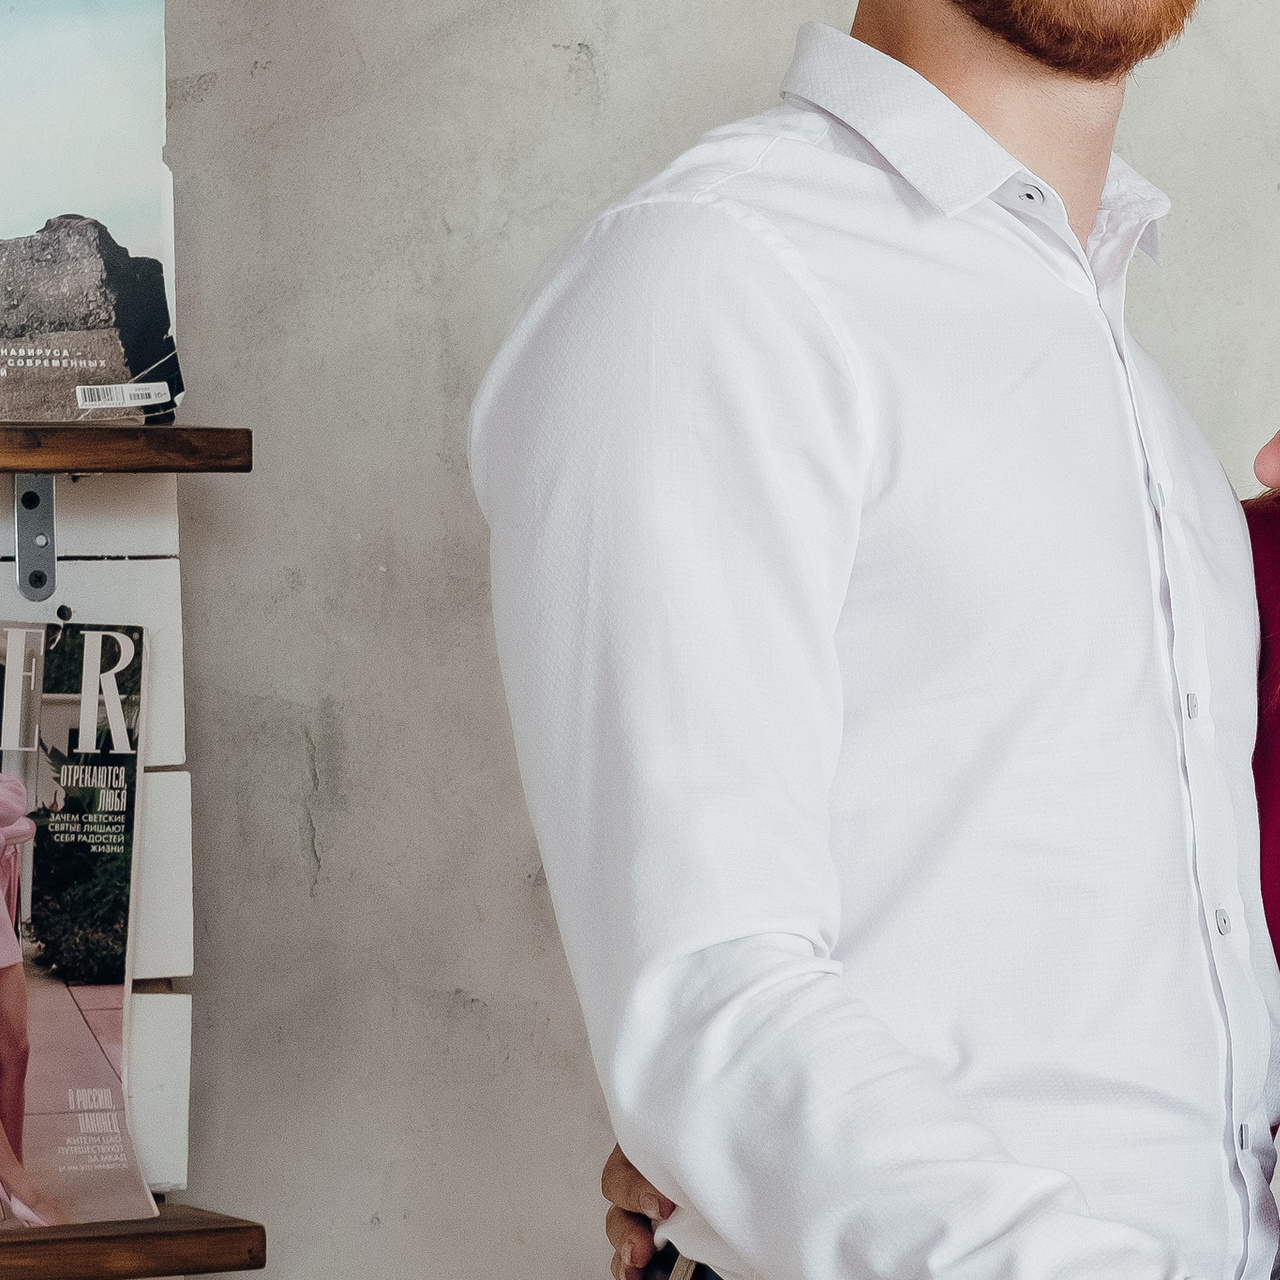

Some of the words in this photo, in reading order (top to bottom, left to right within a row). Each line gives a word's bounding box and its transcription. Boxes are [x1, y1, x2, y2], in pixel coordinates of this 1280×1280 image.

[7, 358, 106, 368] СОВРЕМЕННЫХ
[61, 764, 127, 790] ОТРЕКАЮТСЯ,
[98, 789, 127, 811] ЛЮБЯ
[50, 812, 79, 822] ЗАЧЕМ
[82, 813, 125, 823] СВЕТСКИЕ
[48, 822, 81, 832] СВЯТЫЕ
[83, 823, 125, 833] ЛИШАЮТ
[54, 833, 75, 842] СЕБЯ
[77, 833, 125, 843] РАДОСТЕЙ
[90, 844, 124, 853] ЖИЗНИ
